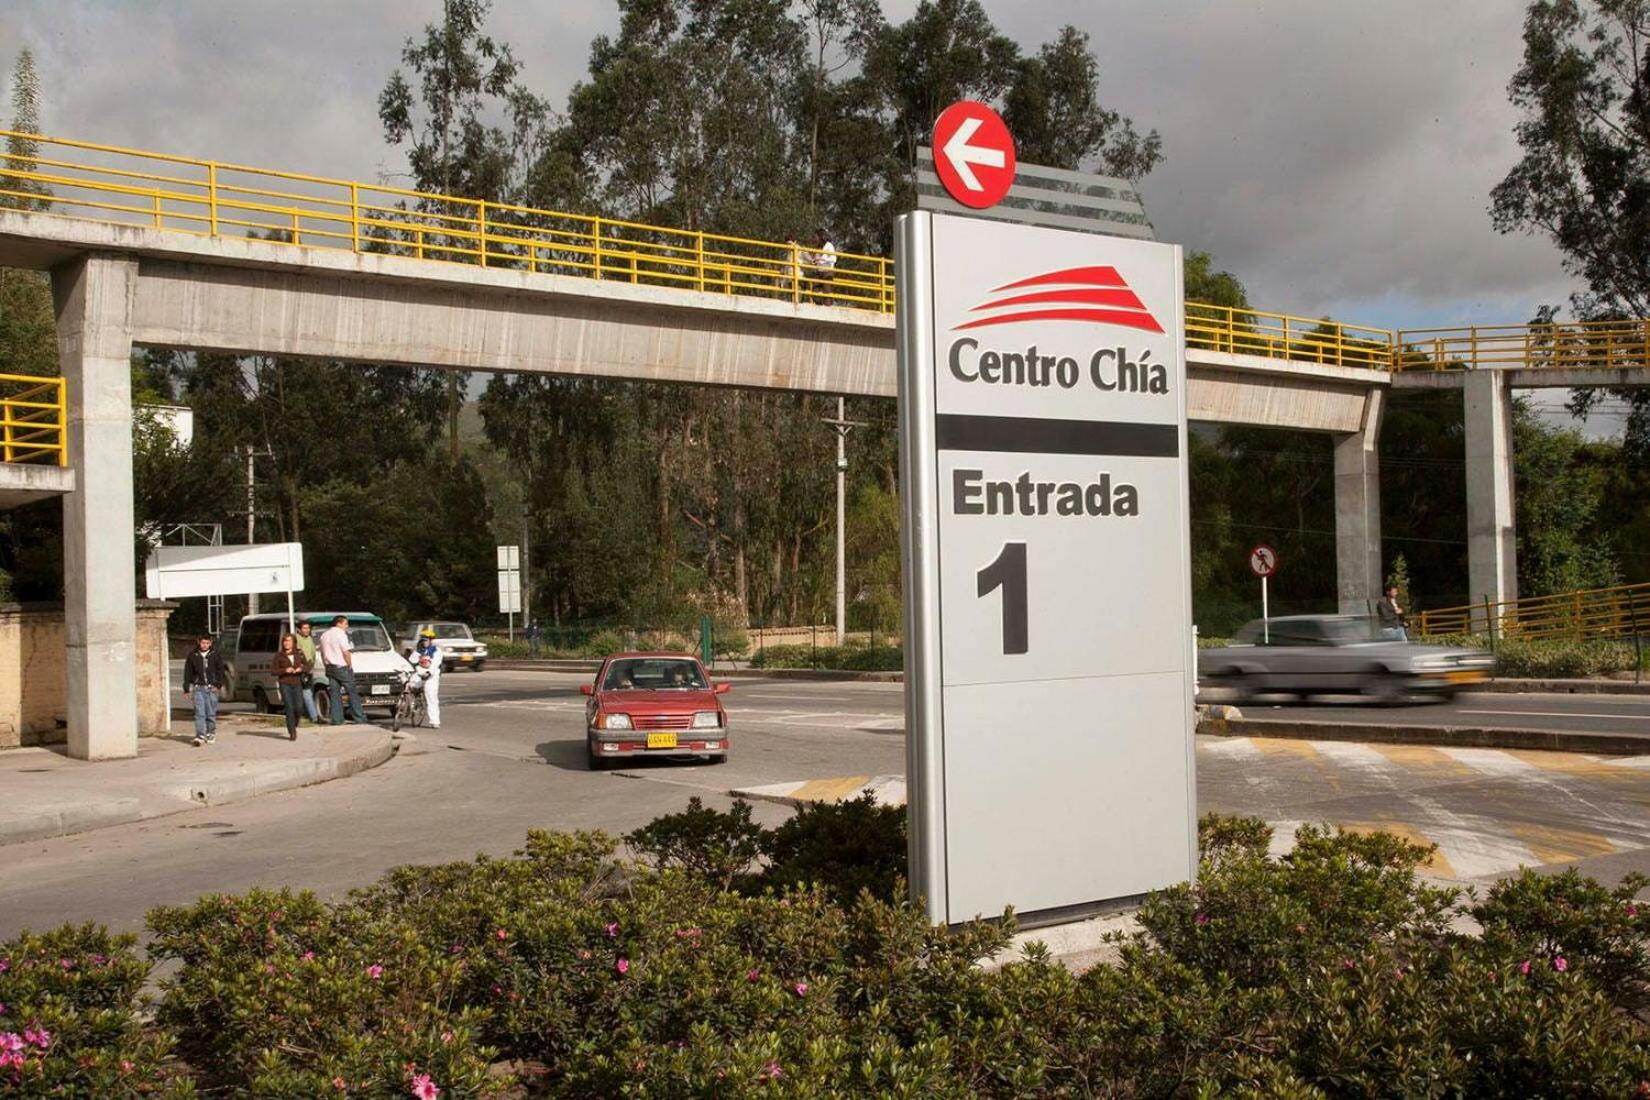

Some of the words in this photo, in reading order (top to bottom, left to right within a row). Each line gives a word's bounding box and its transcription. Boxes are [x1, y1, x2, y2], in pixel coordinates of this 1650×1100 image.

[949, 338, 1079, 388] Centro
[1091, 348, 1169, 394] Chía
[953, 470, 1138, 516] Entrada
[977, 543, 1028, 655] 1
